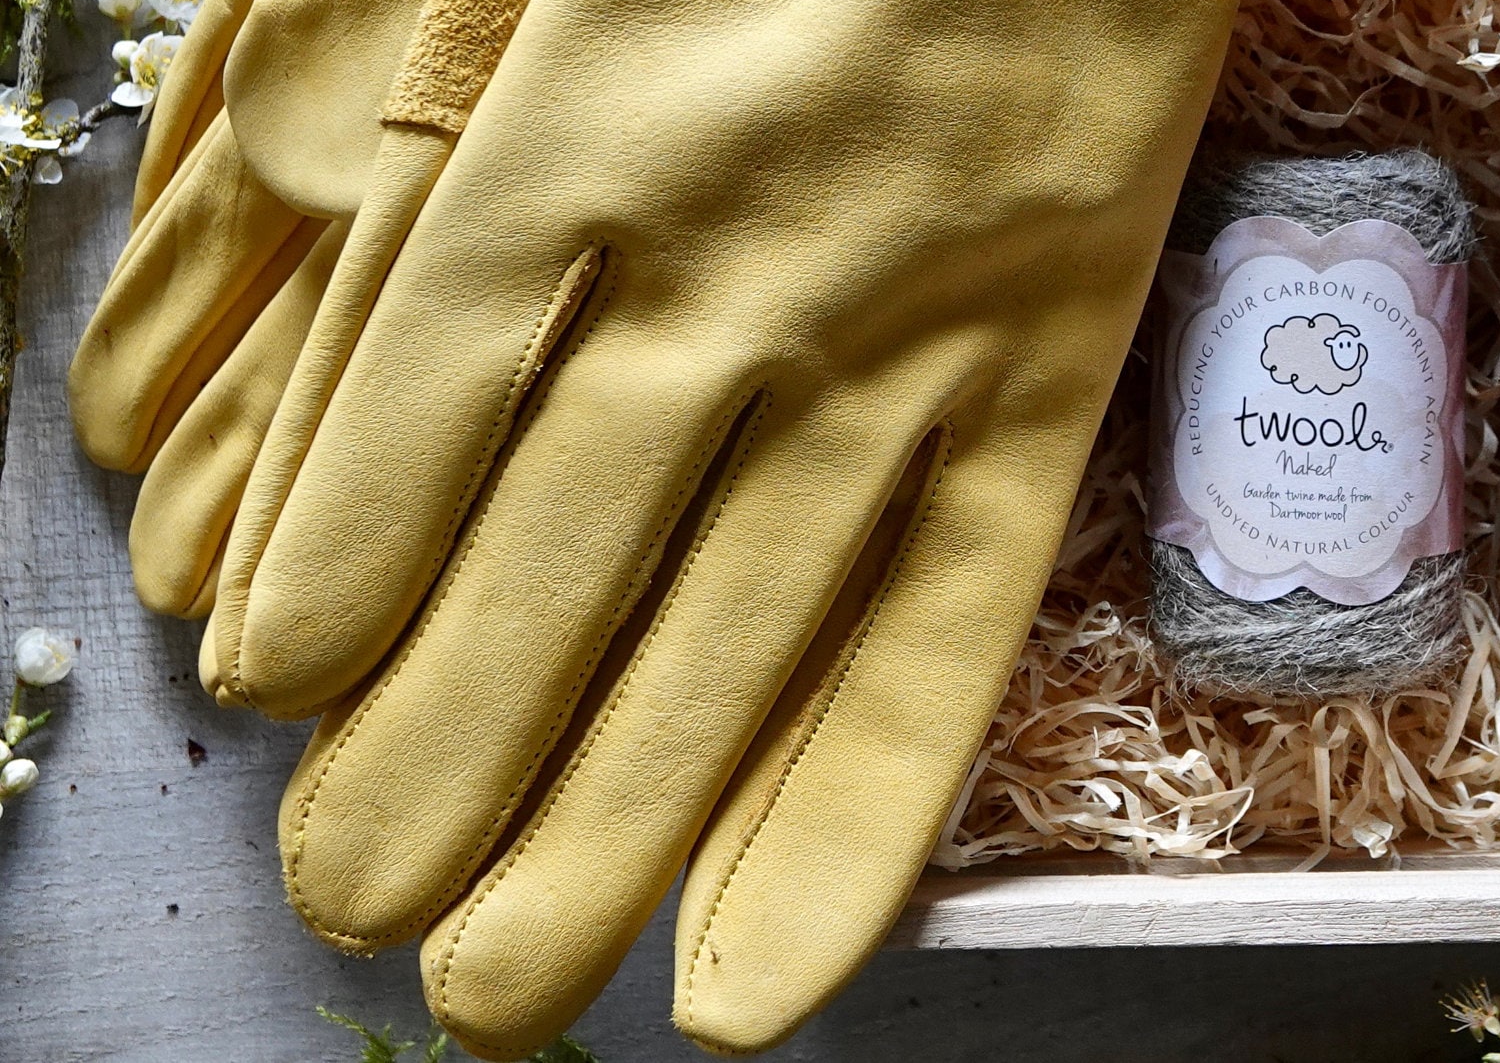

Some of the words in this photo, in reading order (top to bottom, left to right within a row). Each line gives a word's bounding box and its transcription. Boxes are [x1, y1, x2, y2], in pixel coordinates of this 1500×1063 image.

[1188, 345, 1214, 456] REDUCING
[1211, 296, 1258, 338] YOUR
[1263, 281, 1355, 302] CARBON
[1362, 291, 1434, 384] FOOTPRINT
[1419, 394, 1437, 465] AGAIN
[1275, 449, 1338, 479] Naked
[1243, 482, 1281, 500] Garden
[1285, 489, 1315, 501] twine
[1318, 487, 1347, 503] made
[1349, 487, 1373, 504] from
[1206, 483, 1260, 540] UNDYED
[1265, 534, 1353, 555] NATURAL
[1358, 490, 1416, 544] COLOUR
[1269, 501, 1322, 519] Dartmoor
[1324, 503, 1348, 523] wool
